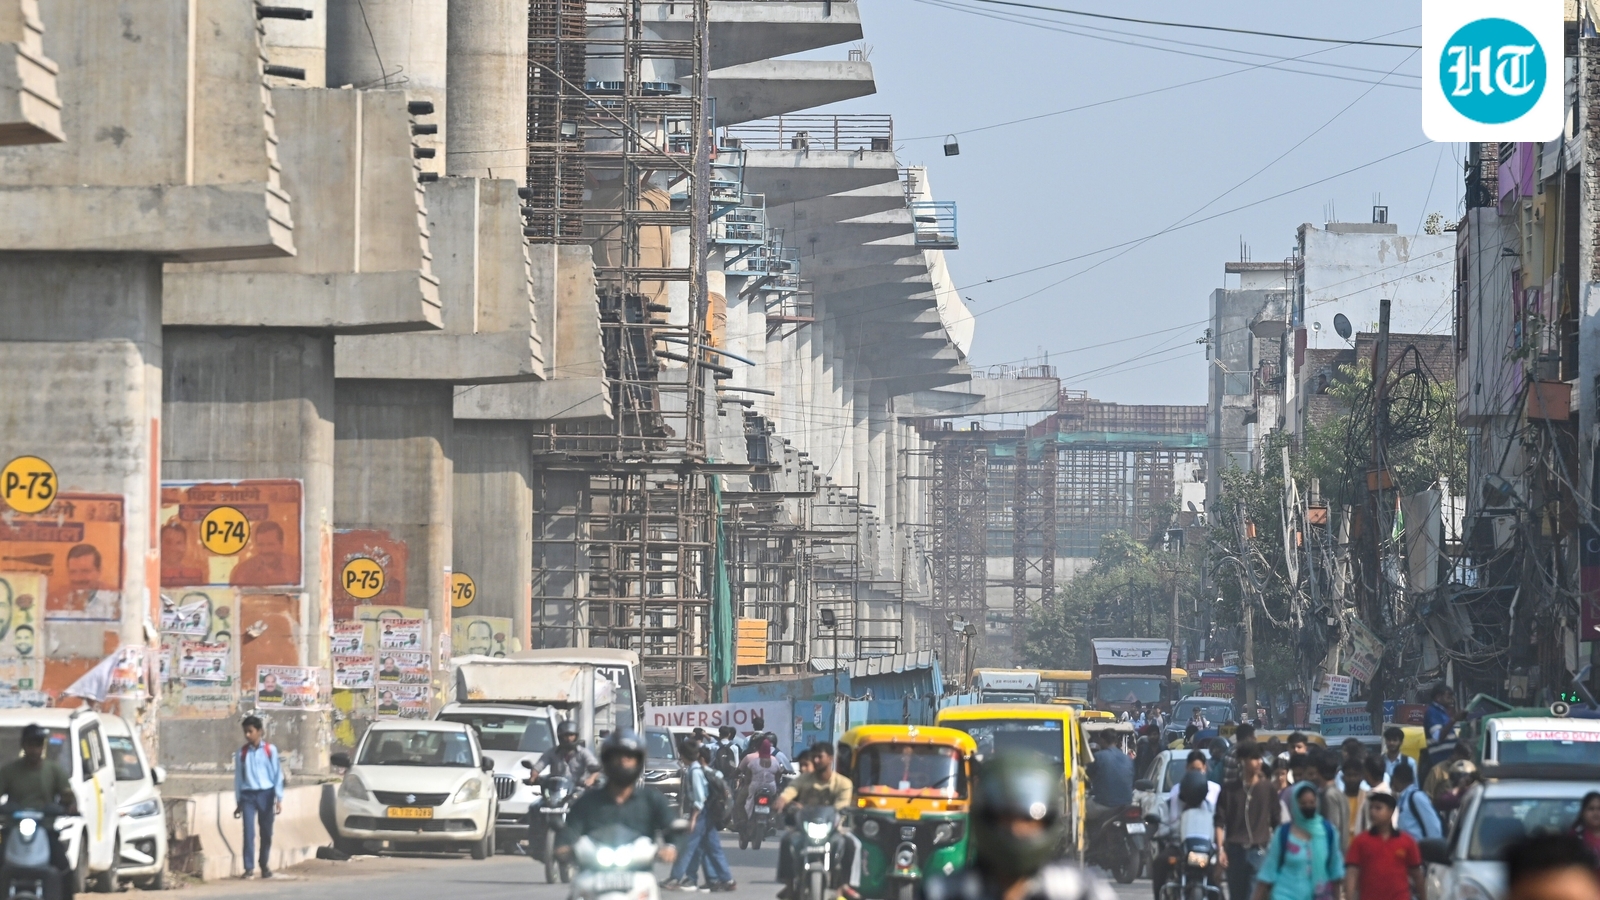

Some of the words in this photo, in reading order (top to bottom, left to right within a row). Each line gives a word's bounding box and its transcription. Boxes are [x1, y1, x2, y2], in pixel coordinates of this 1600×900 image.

[6, 471, 53, 499] P-73
[206, 520, 246, 543] P-74
[346, 570, 380, 589] P-75
[452, 582, 472, 600] -76
[1211, 682, 1226, 691] SHIV
[654, 708, 764, 727] DIVERSION
[1526, 731, 1542, 739] ON
[1544, 731, 1569, 740] MCD
[1572, 731, 1600, 741] DUTY
